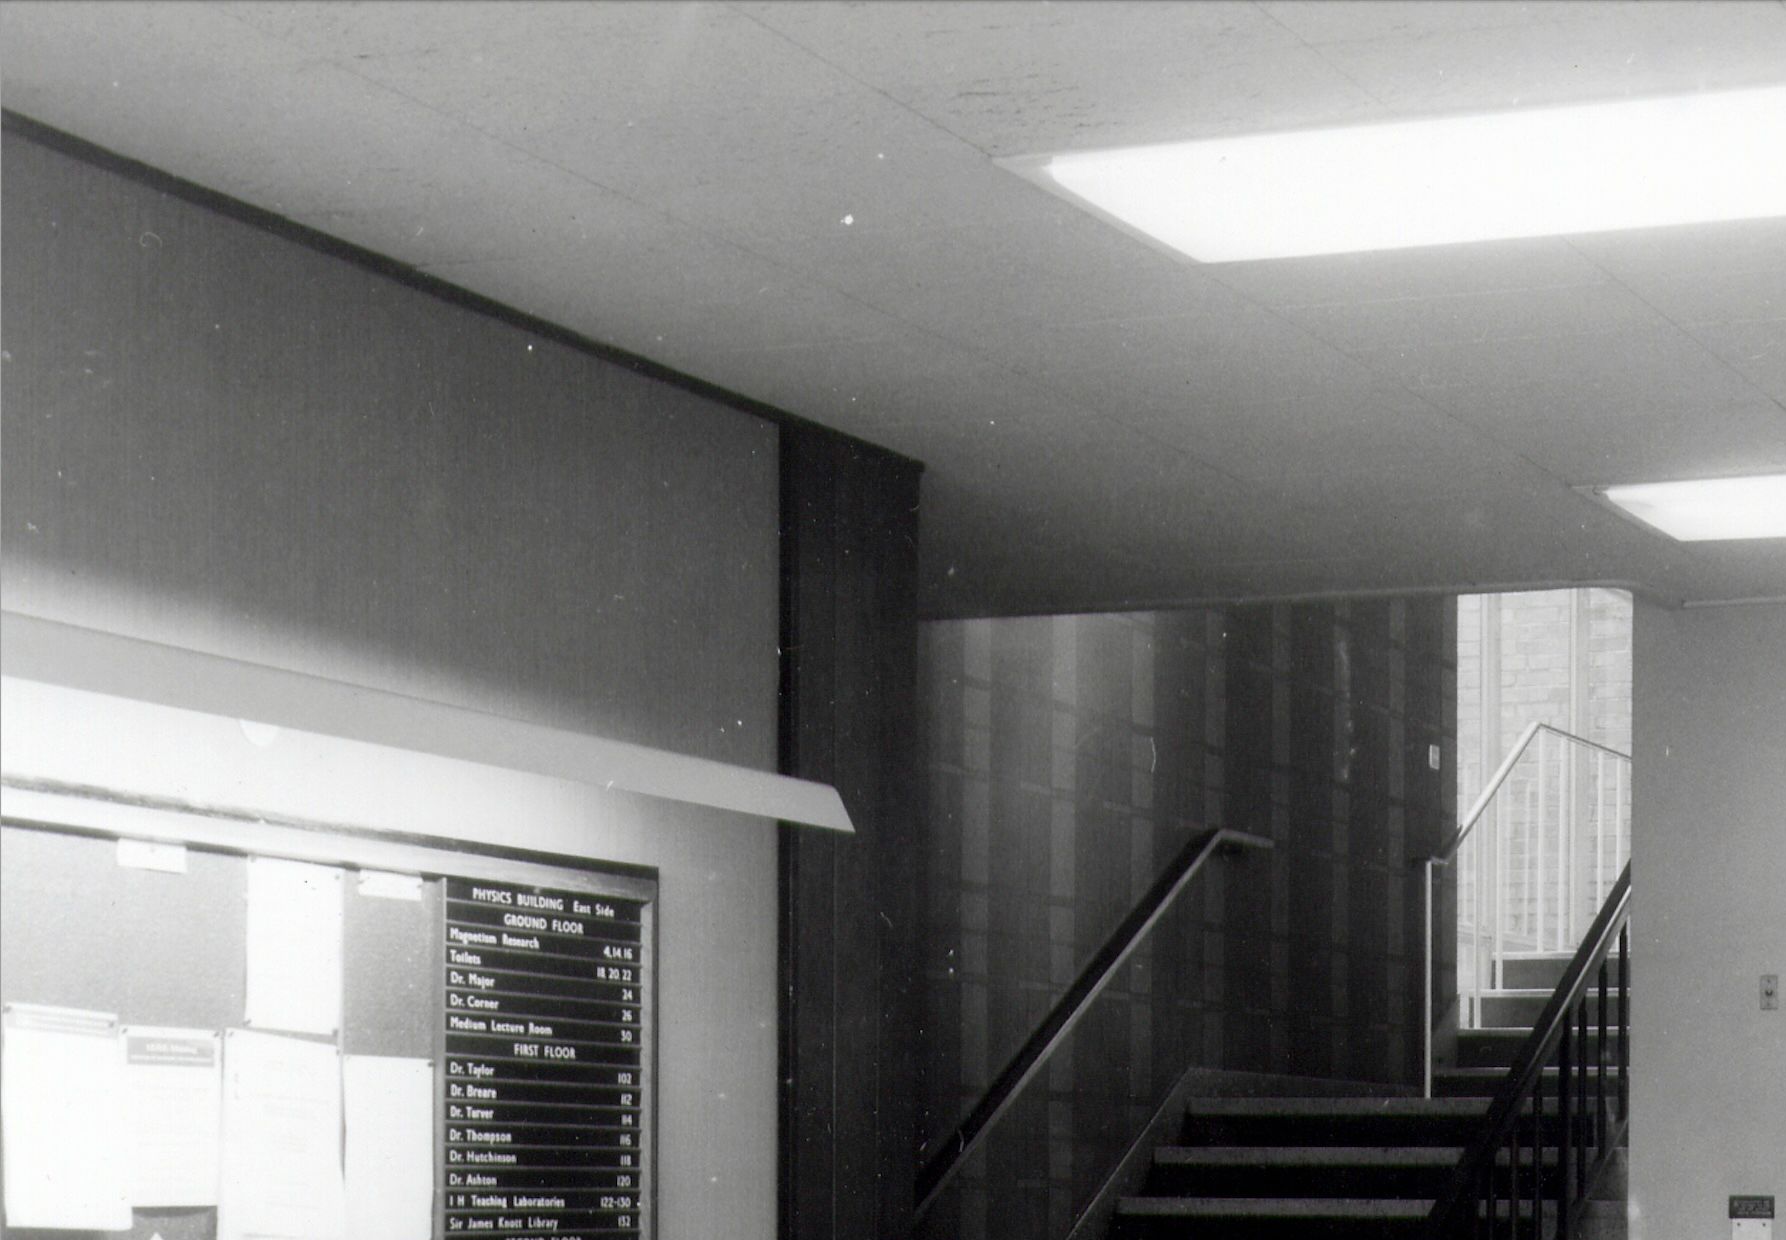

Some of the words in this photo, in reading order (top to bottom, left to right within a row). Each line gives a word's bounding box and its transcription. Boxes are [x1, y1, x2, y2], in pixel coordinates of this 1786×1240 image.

[472, 888, 512, 904] PHYSICS
[517, 894, 563, 911] BUILDING
[573, 901, 591, 915] East
[596, 904, 615, 917] Side
[504, 914, 547, 929] GROUND
[552, 920, 584, 934] FLOOR
[450, 928, 497, 944] Magnetism
[502, 934, 539, 949] Research
[450, 950, 481, 965] Toilets
[450, 972, 465, 984] Dr.
[469, 973, 495, 989] Major
[622, 990, 632, 1000] 24
[450, 994, 465, 1006] Dr.
[467, 996, 499, 1009] Corner
[622, 1010, 632, 1022] 26
[450, 1017, 486, 1030] Medium
[491, 1021, 524, 1033] Lecture
[529, 1023, 552, 1035] Room
[621, 1031, 632, 1042] 30
[514, 1044, 539, 1057] FIRST
[544, 1046, 575, 1059] FLOOR
[450, 1062, 465, 1074] Dr.
[467, 1063, 495, 1078] Taylor
[618, 1073, 632, 1084] 102
[450, 1084, 465, 1096] Dr.
[467, 1086, 497, 1099] Breare
[621, 1094, 632, 1105] 112
[450, 1106, 463, 1118] Dr.
[621, 1115, 632, 1126] 114
[450, 1129, 464, 1141] Dr.
[466, 1130, 511, 1144] Thompson
[620, 1135, 631, 1146] 116
[450, 1151, 464, 1162] Dr.
[466, 1152, 517, 1164] Hutchinson
[620, 1155, 631, 1166] 118
[450, 1174, 464, 1185] Dr.
[466, 1175, 497, 1186] Ashton
[617, 1176, 631, 1187] 120
[471, 1196, 507, 1208] Teaching
[513, 1196, 565, 1208] Laboratories
[450, 1218, 463, 1229] Sir
[468, 1219, 493, 1229] James
[498, 1218, 522, 1228] Knott
[528, 1217, 558, 1232] Library
[618, 1216, 631, 1227] 132
